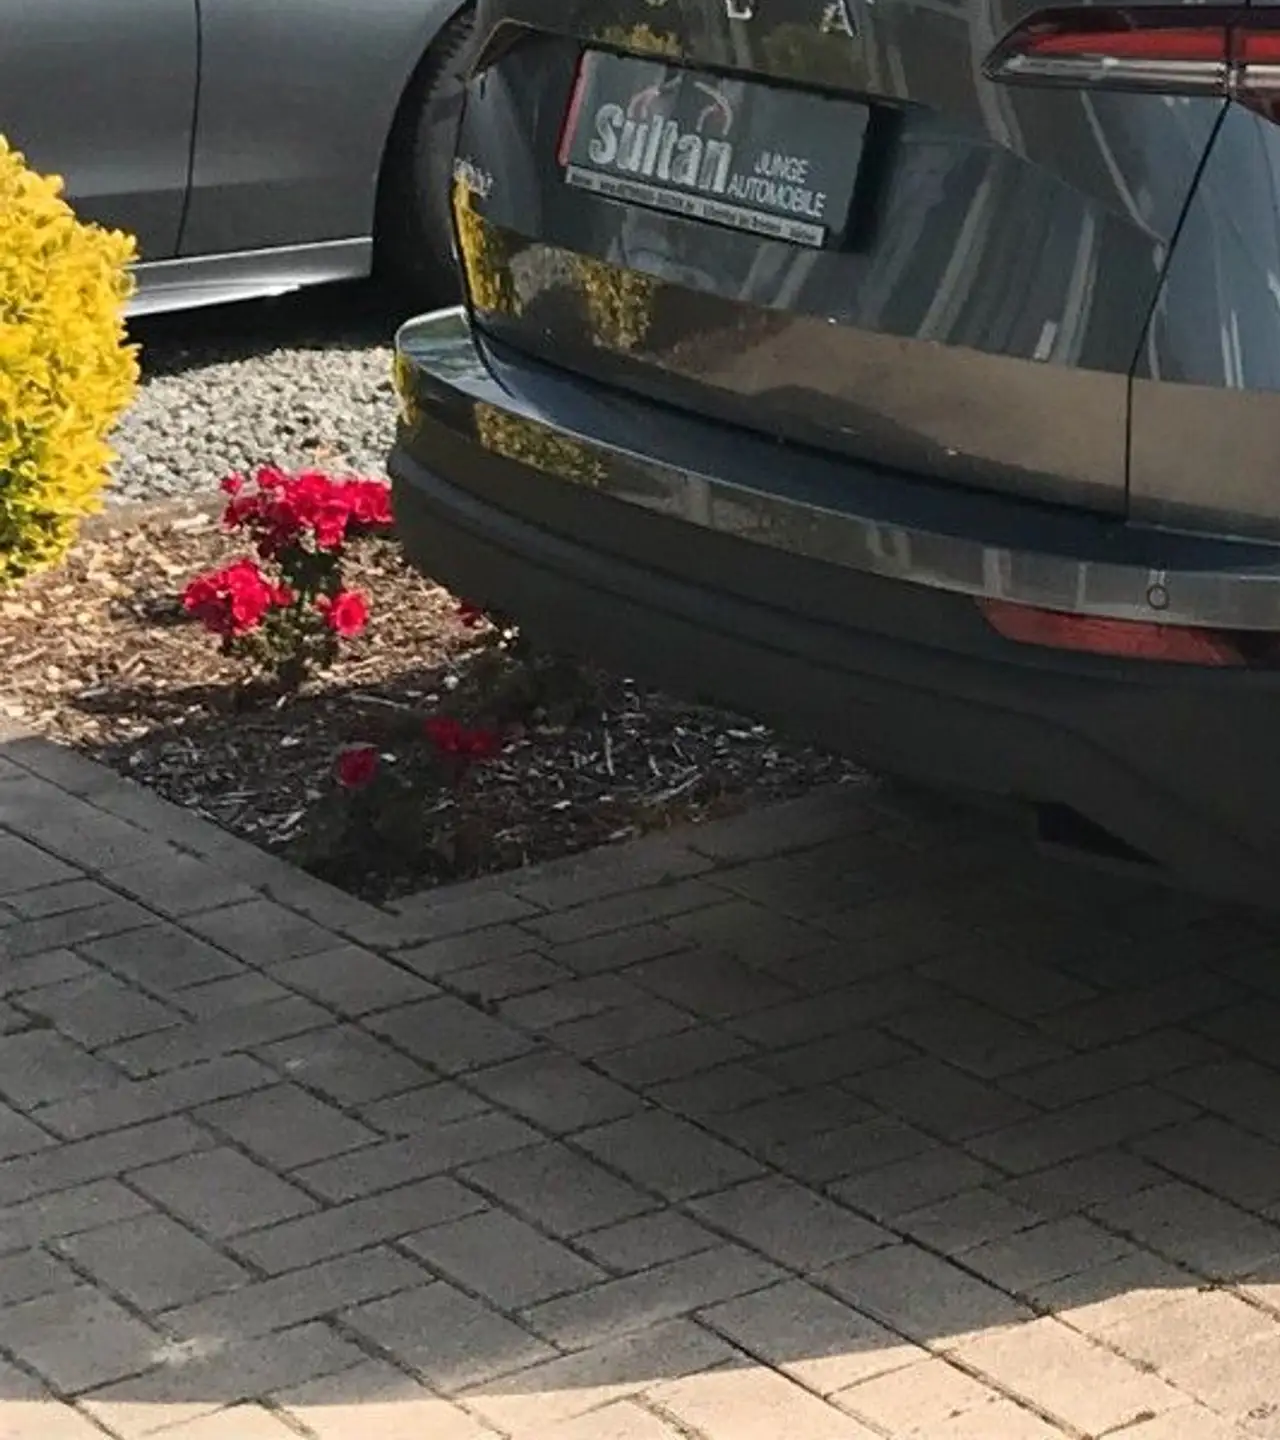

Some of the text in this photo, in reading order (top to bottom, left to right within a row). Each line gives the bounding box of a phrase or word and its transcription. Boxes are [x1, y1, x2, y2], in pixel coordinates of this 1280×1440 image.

[588, 103, 733, 194] Sultan
[754, 151, 809, 185] JUNGE
[726, 173, 828, 219] AUTOMOBILE
